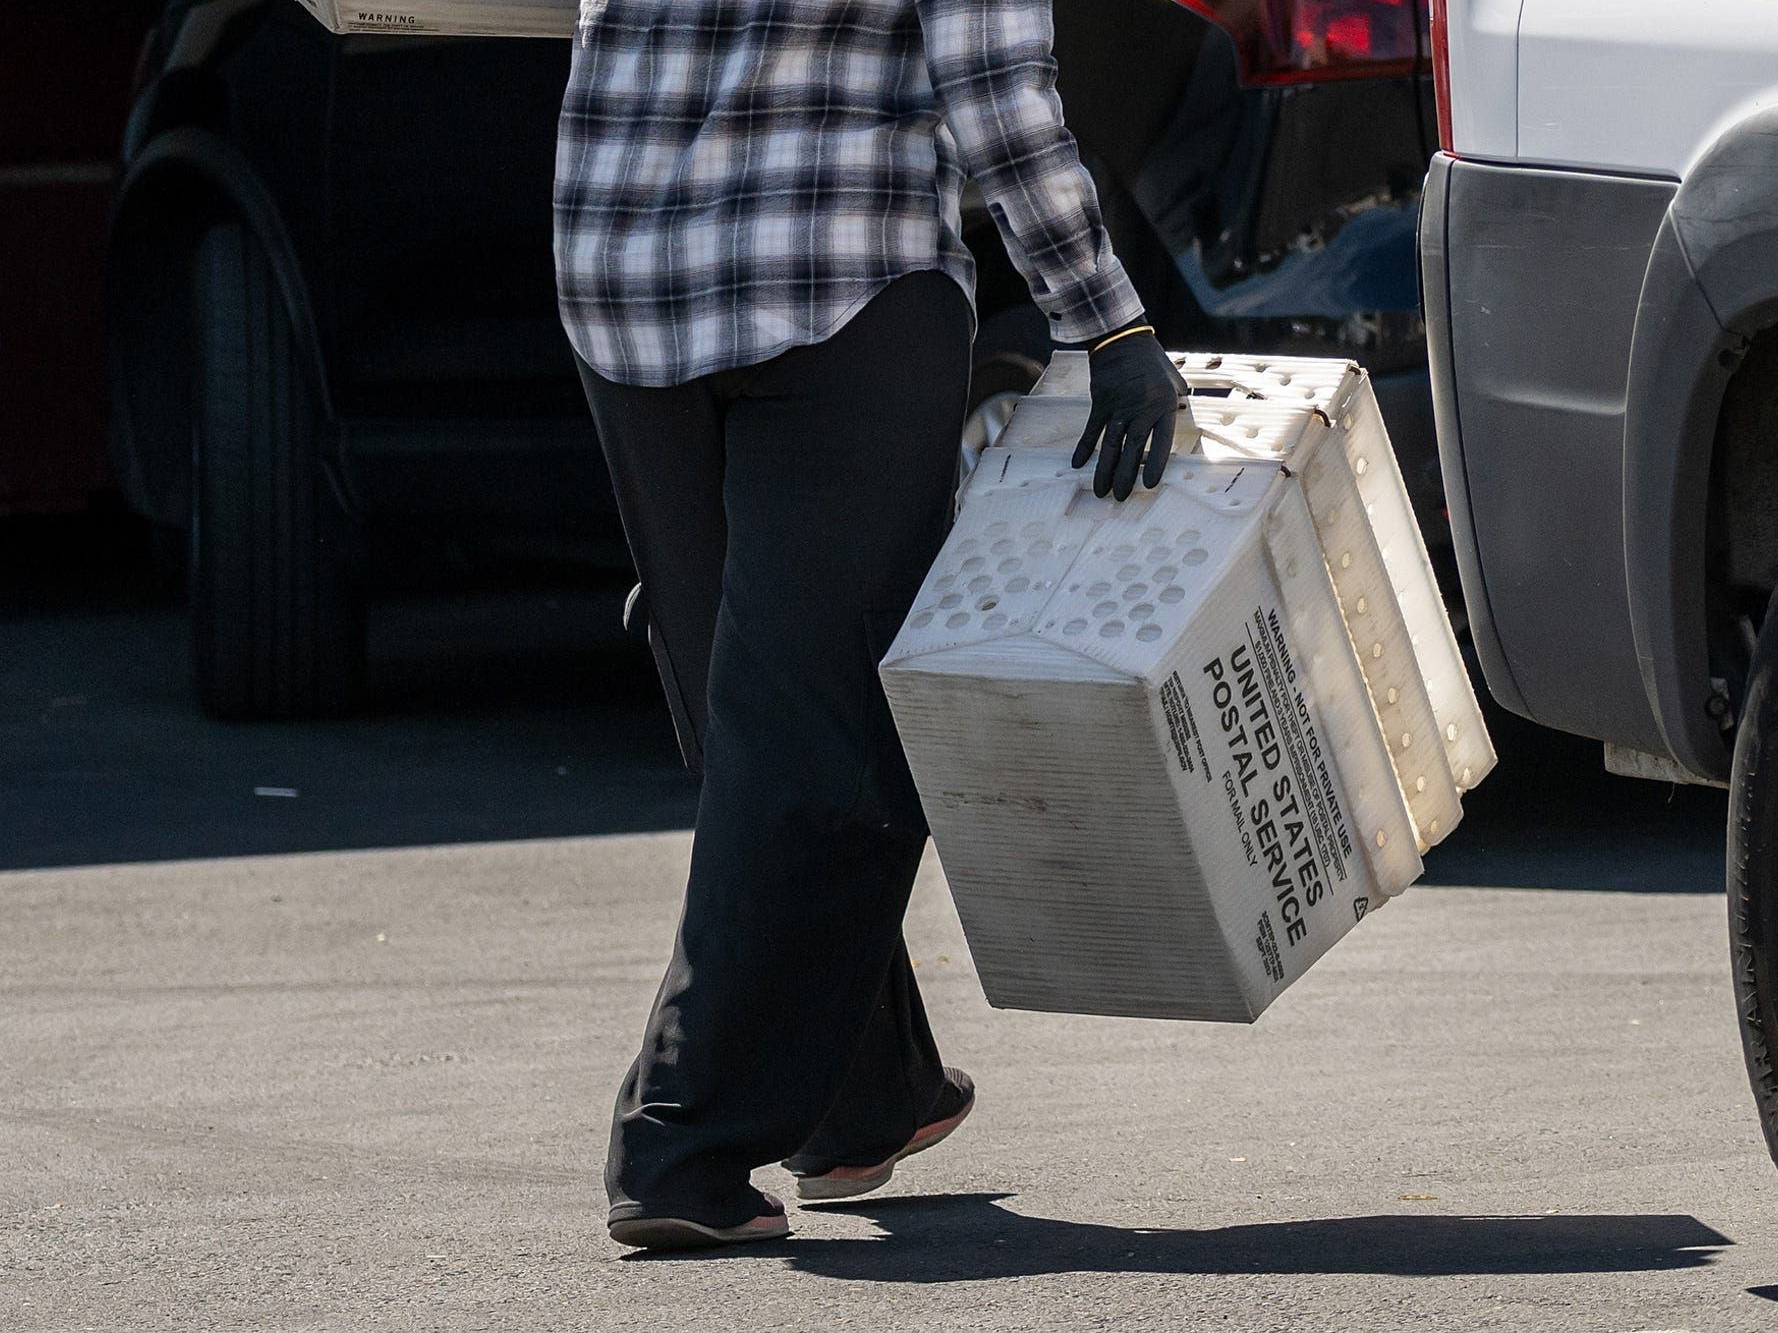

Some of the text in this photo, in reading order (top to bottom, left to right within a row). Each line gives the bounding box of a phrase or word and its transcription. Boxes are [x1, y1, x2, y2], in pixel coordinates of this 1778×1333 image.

[358, 12, 415, 24] WARNING
[1203, 657, 1307, 947] POSTAL SERVICE
[1222, 770, 1258, 866] FOR MAIL ONLY
[1231, 645, 1323, 907] UNITED STATES
[1254, 610, 1273, 656] MAXIMUM
[1268, 653, 1285, 693] PENALTY
[1316, 801, 1331, 837] POSTAL
[1327, 835, 1347, 881] PROPERTY
[1268, 609, 1295, 684] WARNING
[1295, 693, 1310, 725] NOT
[1306, 727, 1321, 763] FOR
[1317, 760, 1342, 825] PRIVATE
[1338, 824, 1352, 858] USE
[1287, 744, 1314, 810] IMPRISONMENT
